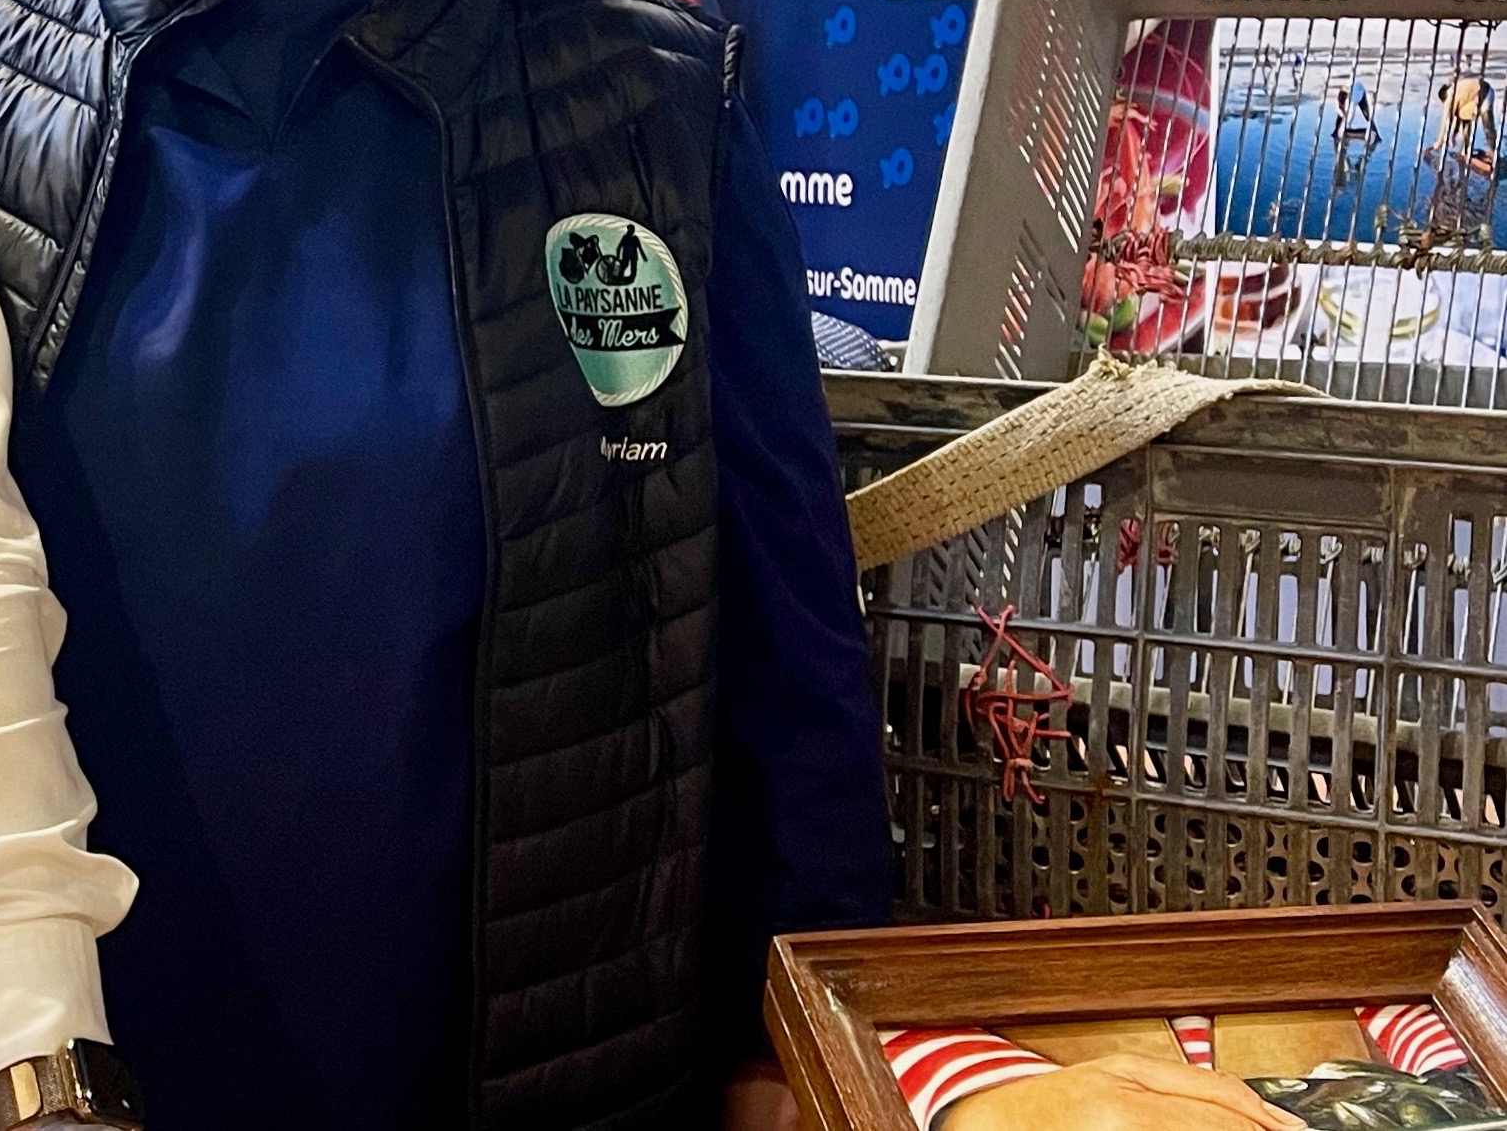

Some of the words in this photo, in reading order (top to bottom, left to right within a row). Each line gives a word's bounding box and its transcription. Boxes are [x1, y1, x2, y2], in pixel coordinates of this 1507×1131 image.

[780, 170, 853, 207] mme
[556, 282, 572, 310] LA
[575, 284, 664, 313] PAYSANNE
[806, 266, 917, 307] sur-Somme
[597, 318, 660, 348] Mers
